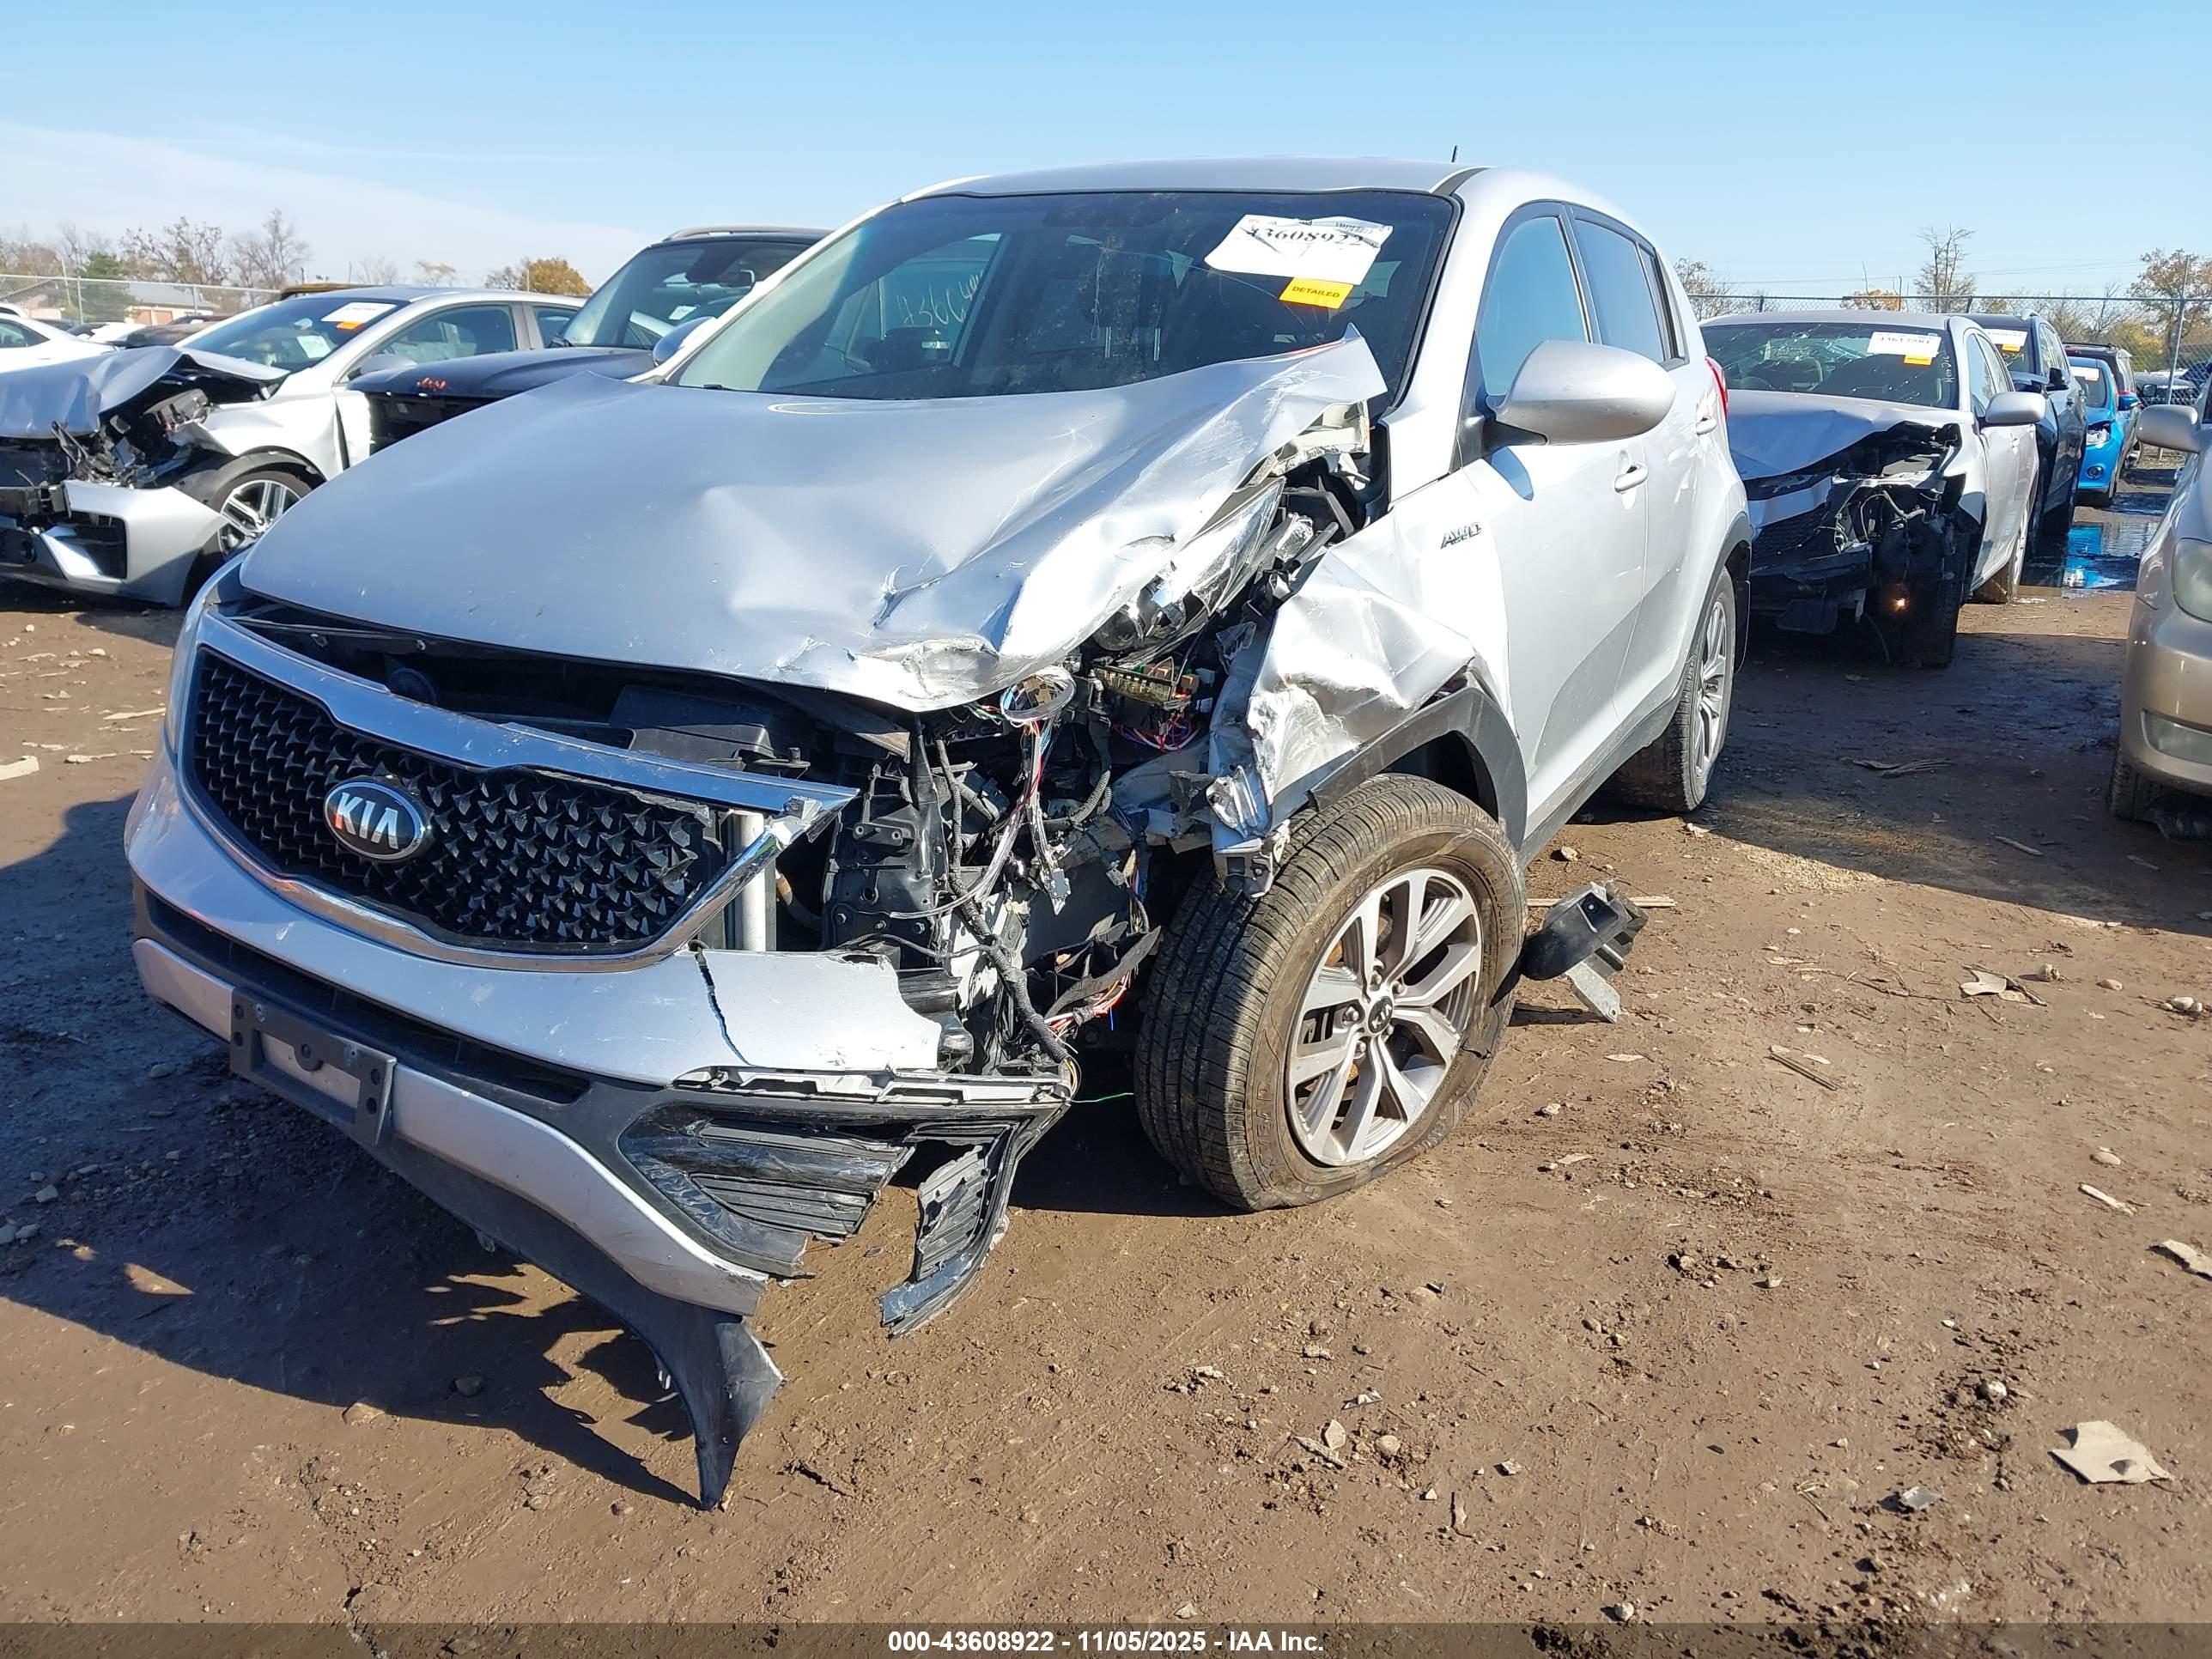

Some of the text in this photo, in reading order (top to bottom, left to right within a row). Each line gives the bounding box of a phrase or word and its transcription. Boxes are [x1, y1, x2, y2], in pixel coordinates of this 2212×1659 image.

[1291, 286, 1340, 298] DETAILED
[335, 792, 399, 849] KIA
[1370, 1003, 1393, 1030] KIA
